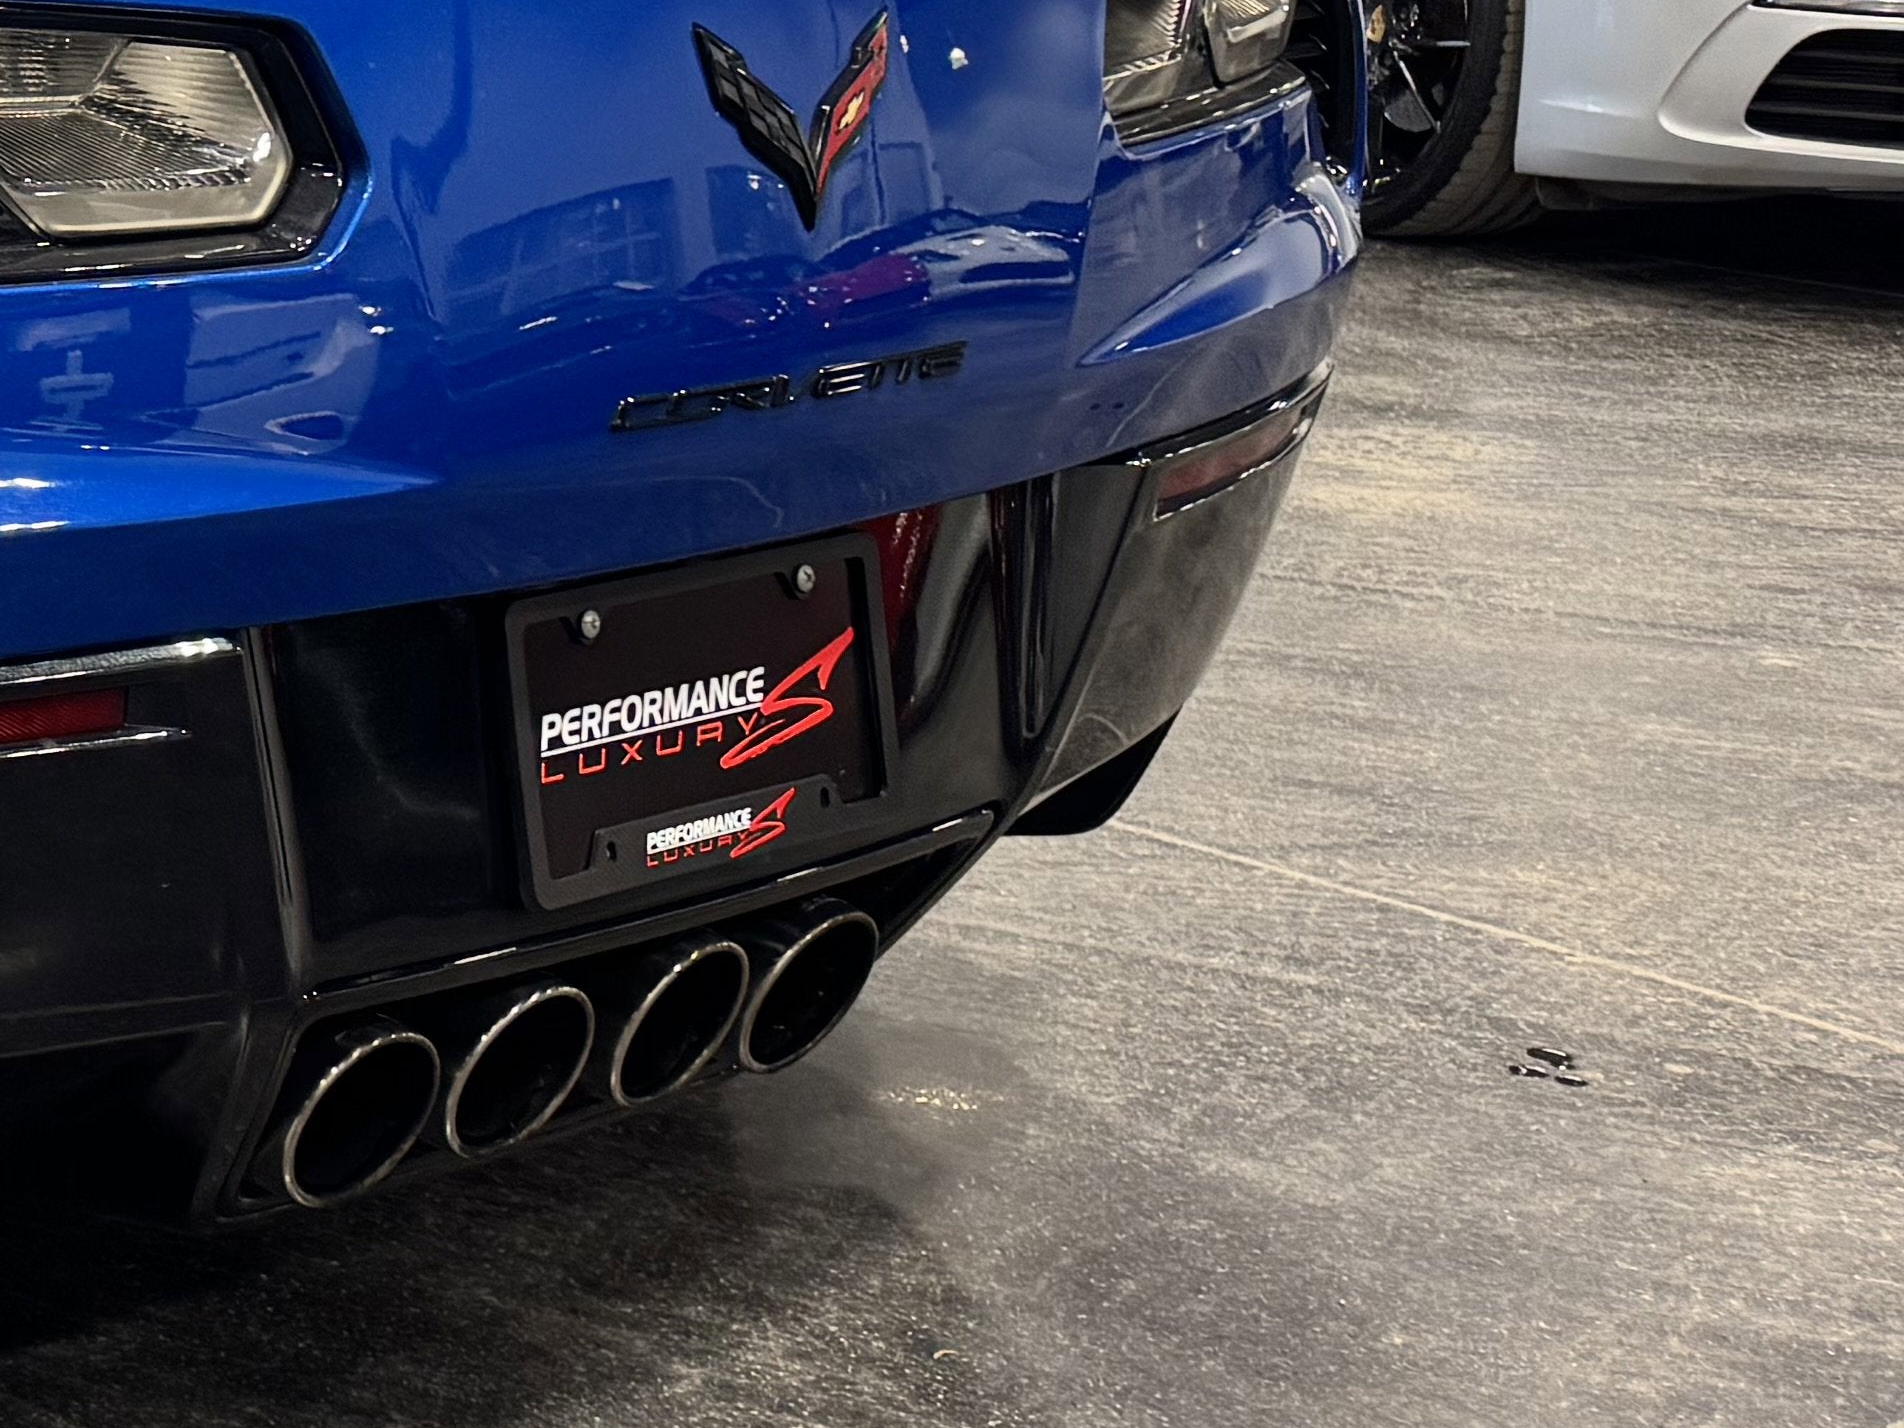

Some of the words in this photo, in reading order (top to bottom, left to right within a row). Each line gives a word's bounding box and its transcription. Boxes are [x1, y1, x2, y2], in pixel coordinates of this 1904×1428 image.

[540, 666, 765, 751] PERFORMANCE
[540, 711, 760, 785] LUXURY
[646, 806, 753, 855] PERFORMANCE
[646, 830, 750, 869] LUXURY
